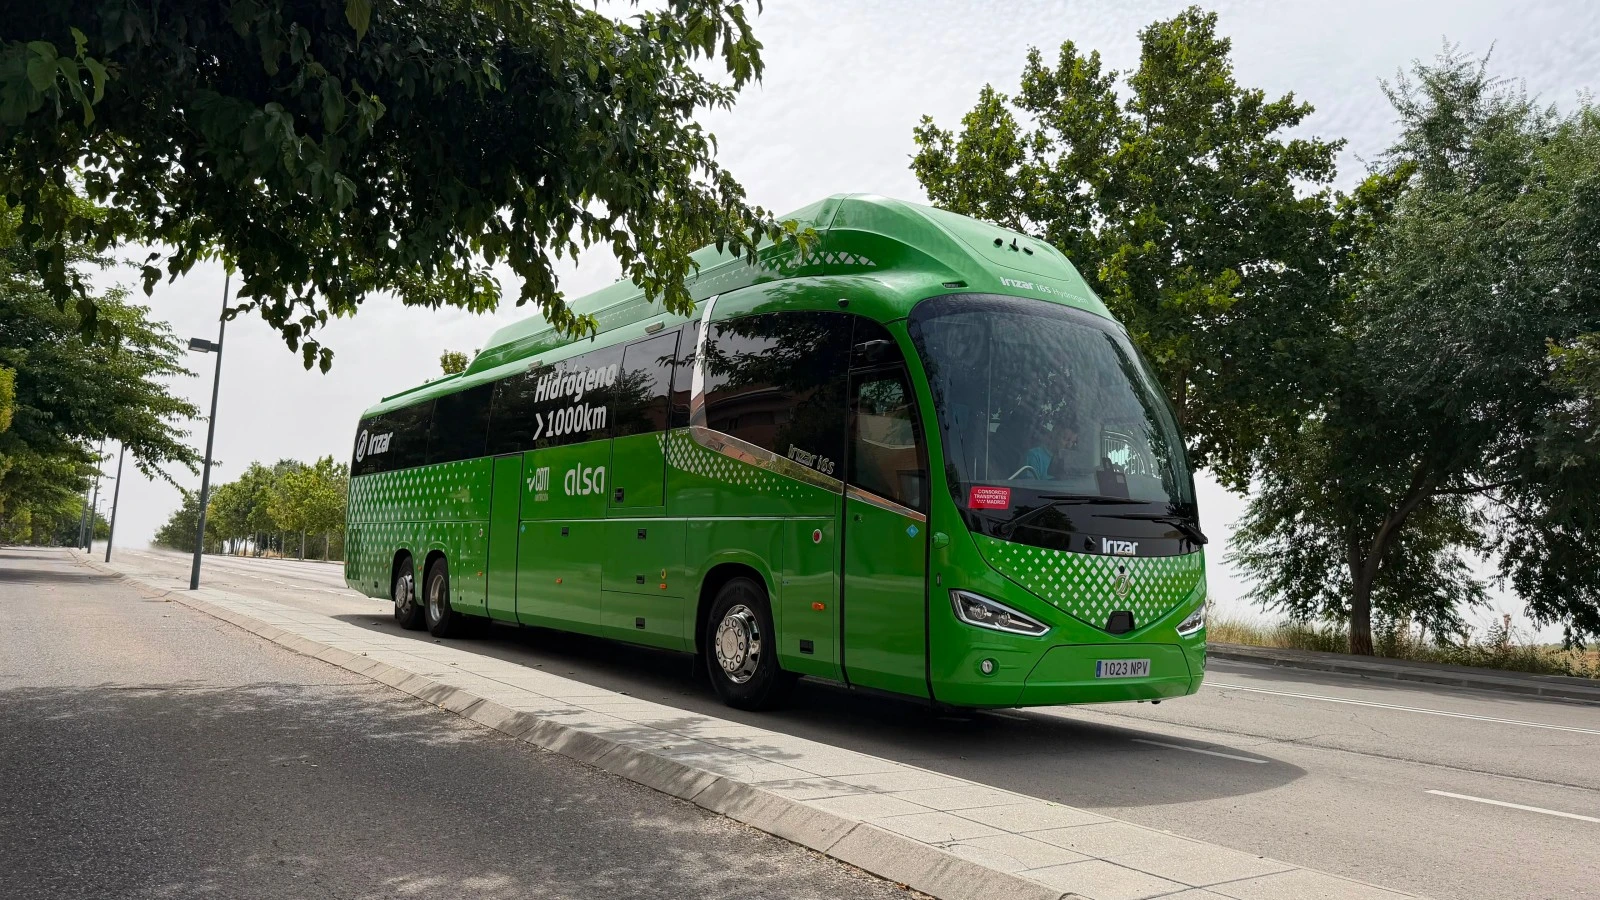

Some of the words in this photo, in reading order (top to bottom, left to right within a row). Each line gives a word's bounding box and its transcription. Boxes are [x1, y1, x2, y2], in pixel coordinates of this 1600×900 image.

[1000, 276, 1033, 290] Irizar
[1052, 287, 1089, 304] Hydrogen
[534, 363, 617, 403] Hidrógeno
[367, 431, 394, 455] Irizar
[787, 443, 817, 467] Irizar
[564, 461, 606, 496] alsa
[1102, 537, 1139, 555] Irizar
[1104, 662, 1128, 675] 1023
[1130, 661, 1148, 675] NPV
